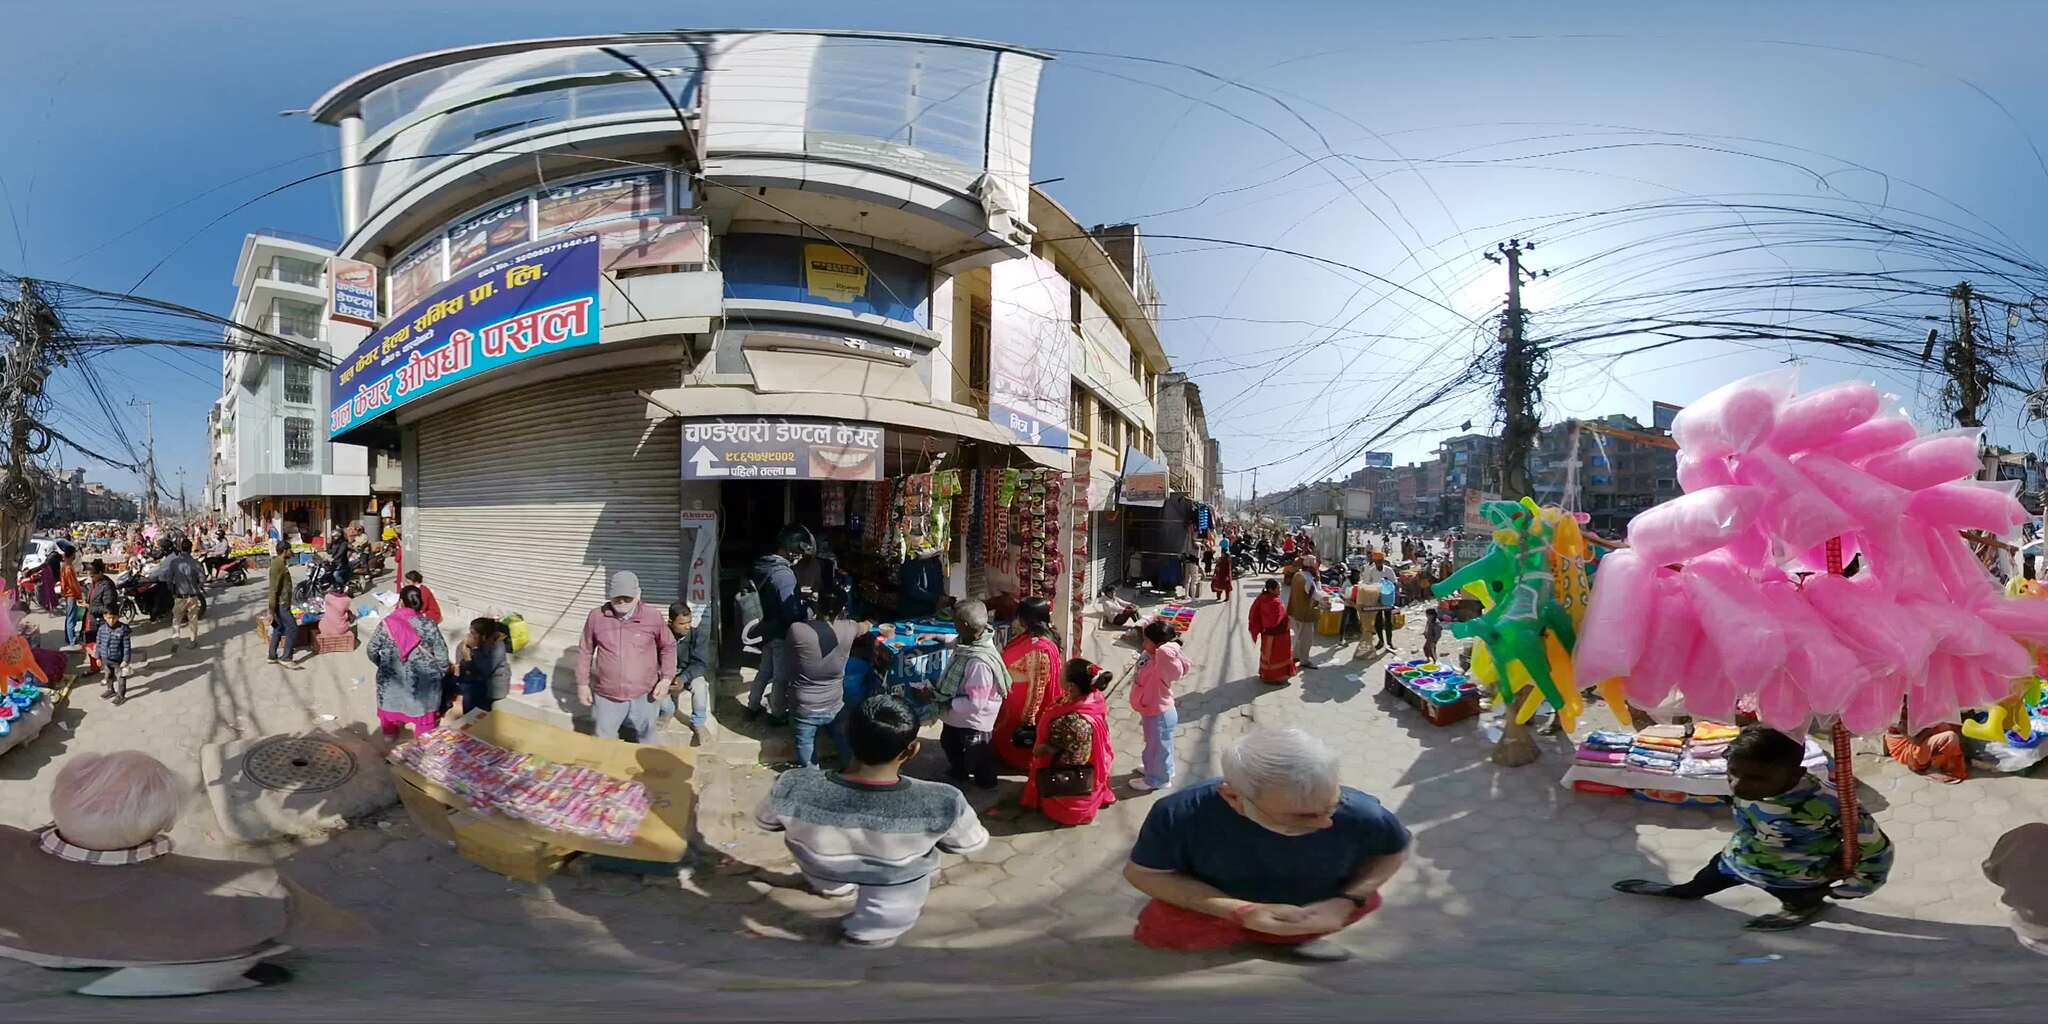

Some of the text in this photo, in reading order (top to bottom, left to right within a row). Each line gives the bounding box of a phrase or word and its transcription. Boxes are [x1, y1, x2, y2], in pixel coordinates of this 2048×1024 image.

[505, 264, 549, 289] लि.
[335, 290, 373, 308] डेण्टल
[331, 399, 353, 431] अल
[353, 383, 394, 417] केयर
[479, 297, 593, 357] पसल
[685, 416, 880, 448] चण्डेश्वरी डेण्टल केयर
[730, 464, 758, 477] पहिलो
